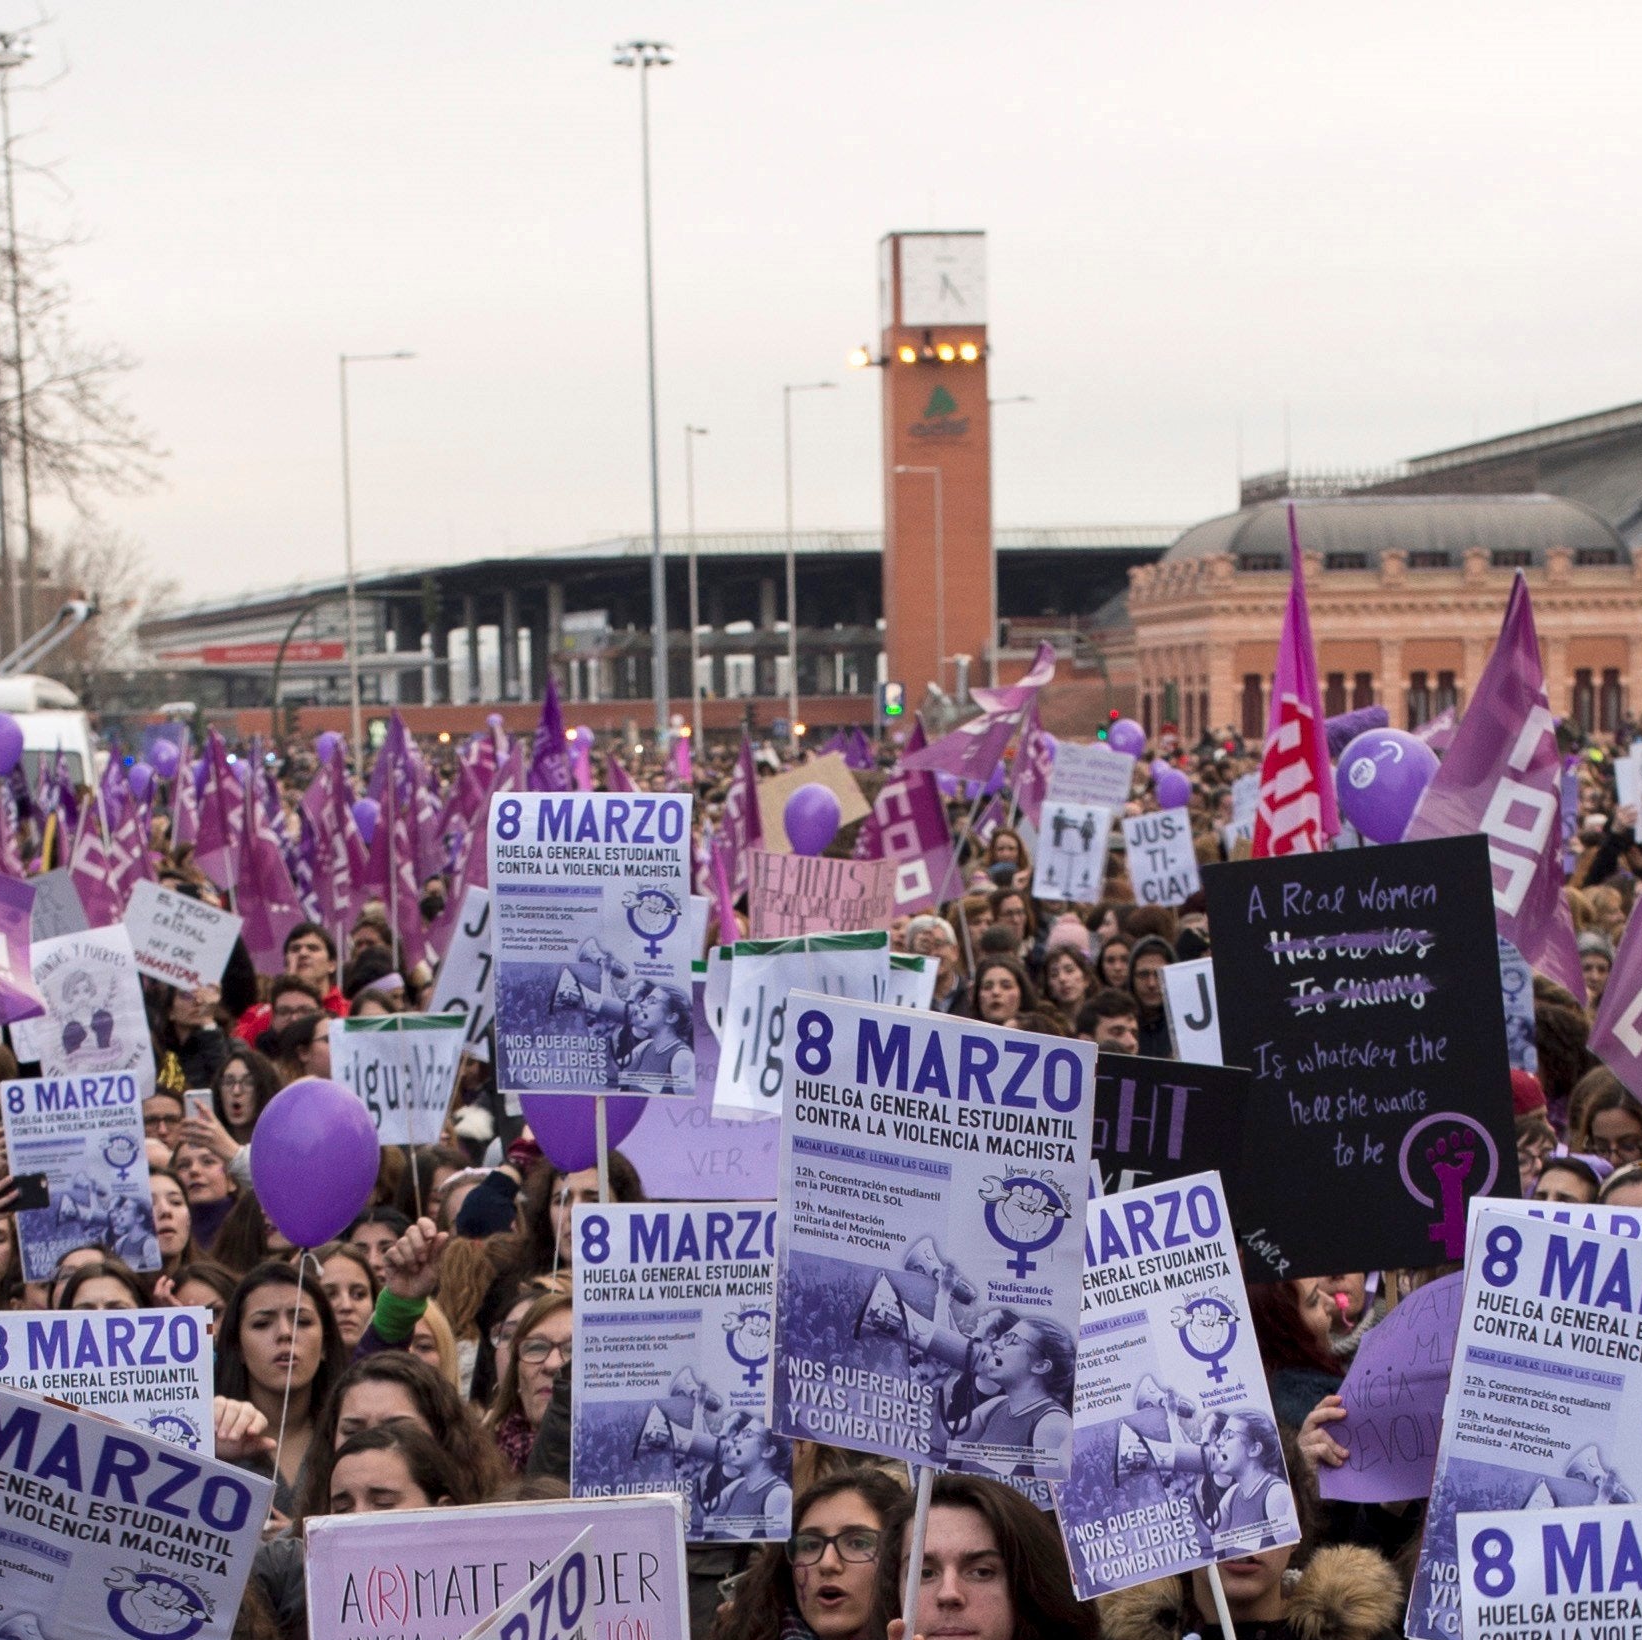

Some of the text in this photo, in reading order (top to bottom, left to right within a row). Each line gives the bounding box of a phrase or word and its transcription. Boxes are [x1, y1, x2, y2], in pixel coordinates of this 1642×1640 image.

[491, 797, 682, 844] 8 MARZO
[1130, 817, 1184, 846] JUS-
[1247, 886, 1267, 923] A
[1282, 880, 1345, 917] Real
[795, 1011, 1083, 1112] 8 MARZO
[1253, 1033, 1447, 1080] Is whatever the
[5, 1075, 136, 1114] 8 MARZO
[796, 1080, 1077, 1140] HUELGA GENERAL ESTUDIANTIL
[1289, 1088, 1427, 1126] hell she wants
[796, 1105, 1075, 1164] CONTRA LA VIOLENCIA MACHISTA
[1333, 1132, 1385, 1168] to be
[797, 1167, 940, 1201] 12h. Concentración estudiantil
[809, 1181, 817, 1190] la
[820, 1182, 860, 1198] PUERTA
[862, 1190, 880, 1202] DEL
[884, 1195, 903, 1206] SOL
[794, 1214, 907, 1242] unitaria del Movimiento
[795, 1201, 884, 1225] 19h. Manifestación
[794, 1224, 890, 1251] Feminista ATOCHA
[1481, 1225, 1521, 1287] 8
[26, 1314, 200, 1370] MARZO
[789, 1356, 933, 1406] NOS QUEREMOS
[789, 1378, 932, 1429] VIVAS, LIBRES
[788, 1404, 931, 1453] Y COMBATIVAS
[1471, 1528, 1515, 1598] 8
